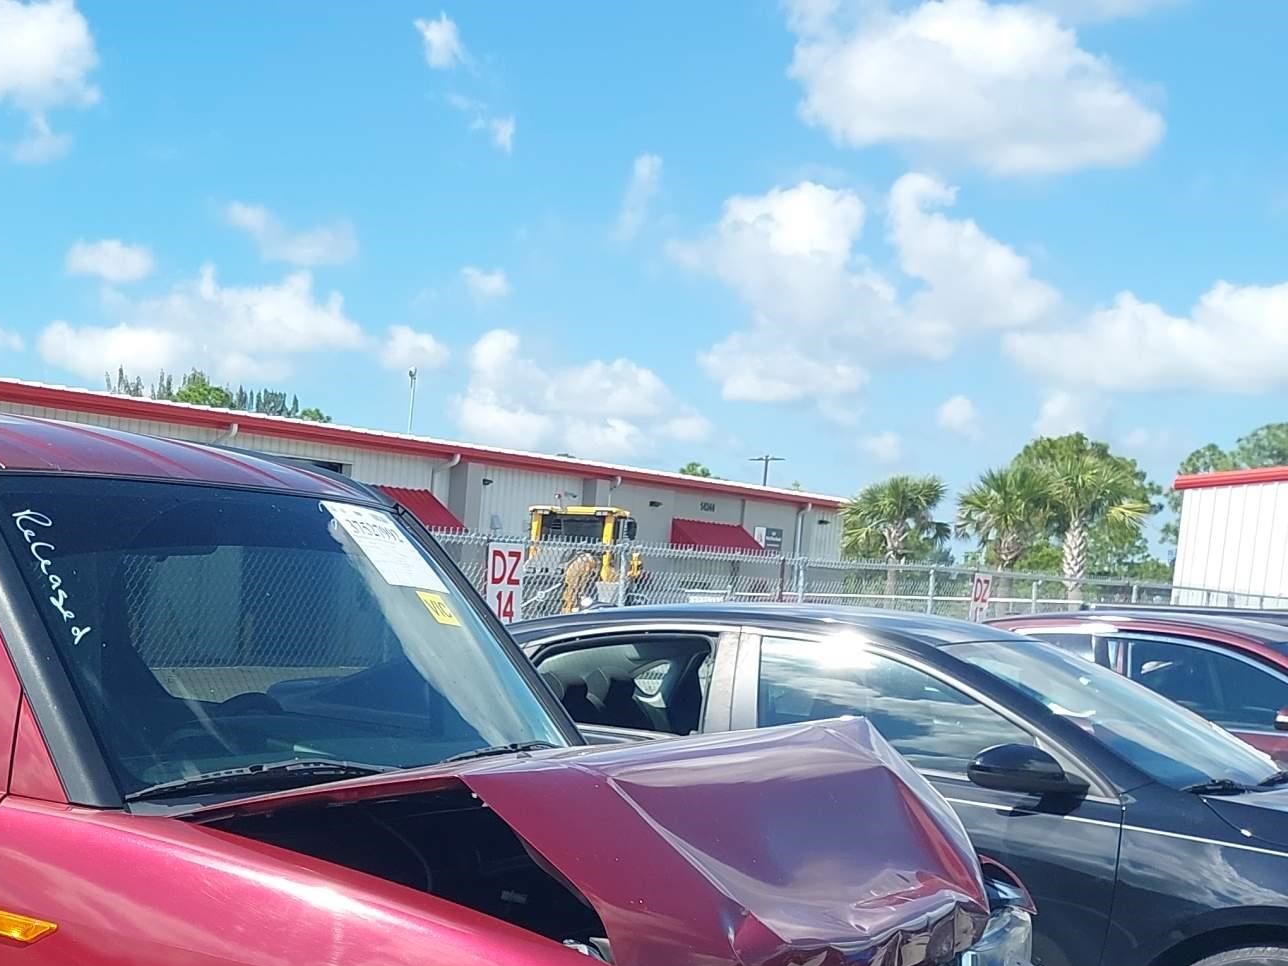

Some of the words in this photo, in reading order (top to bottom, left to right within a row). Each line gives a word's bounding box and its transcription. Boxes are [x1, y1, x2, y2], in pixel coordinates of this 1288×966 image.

[491, 549, 522, 585] DZ
[495, 589, 515, 624] 14
[973, 578, 990, 603] DZ
